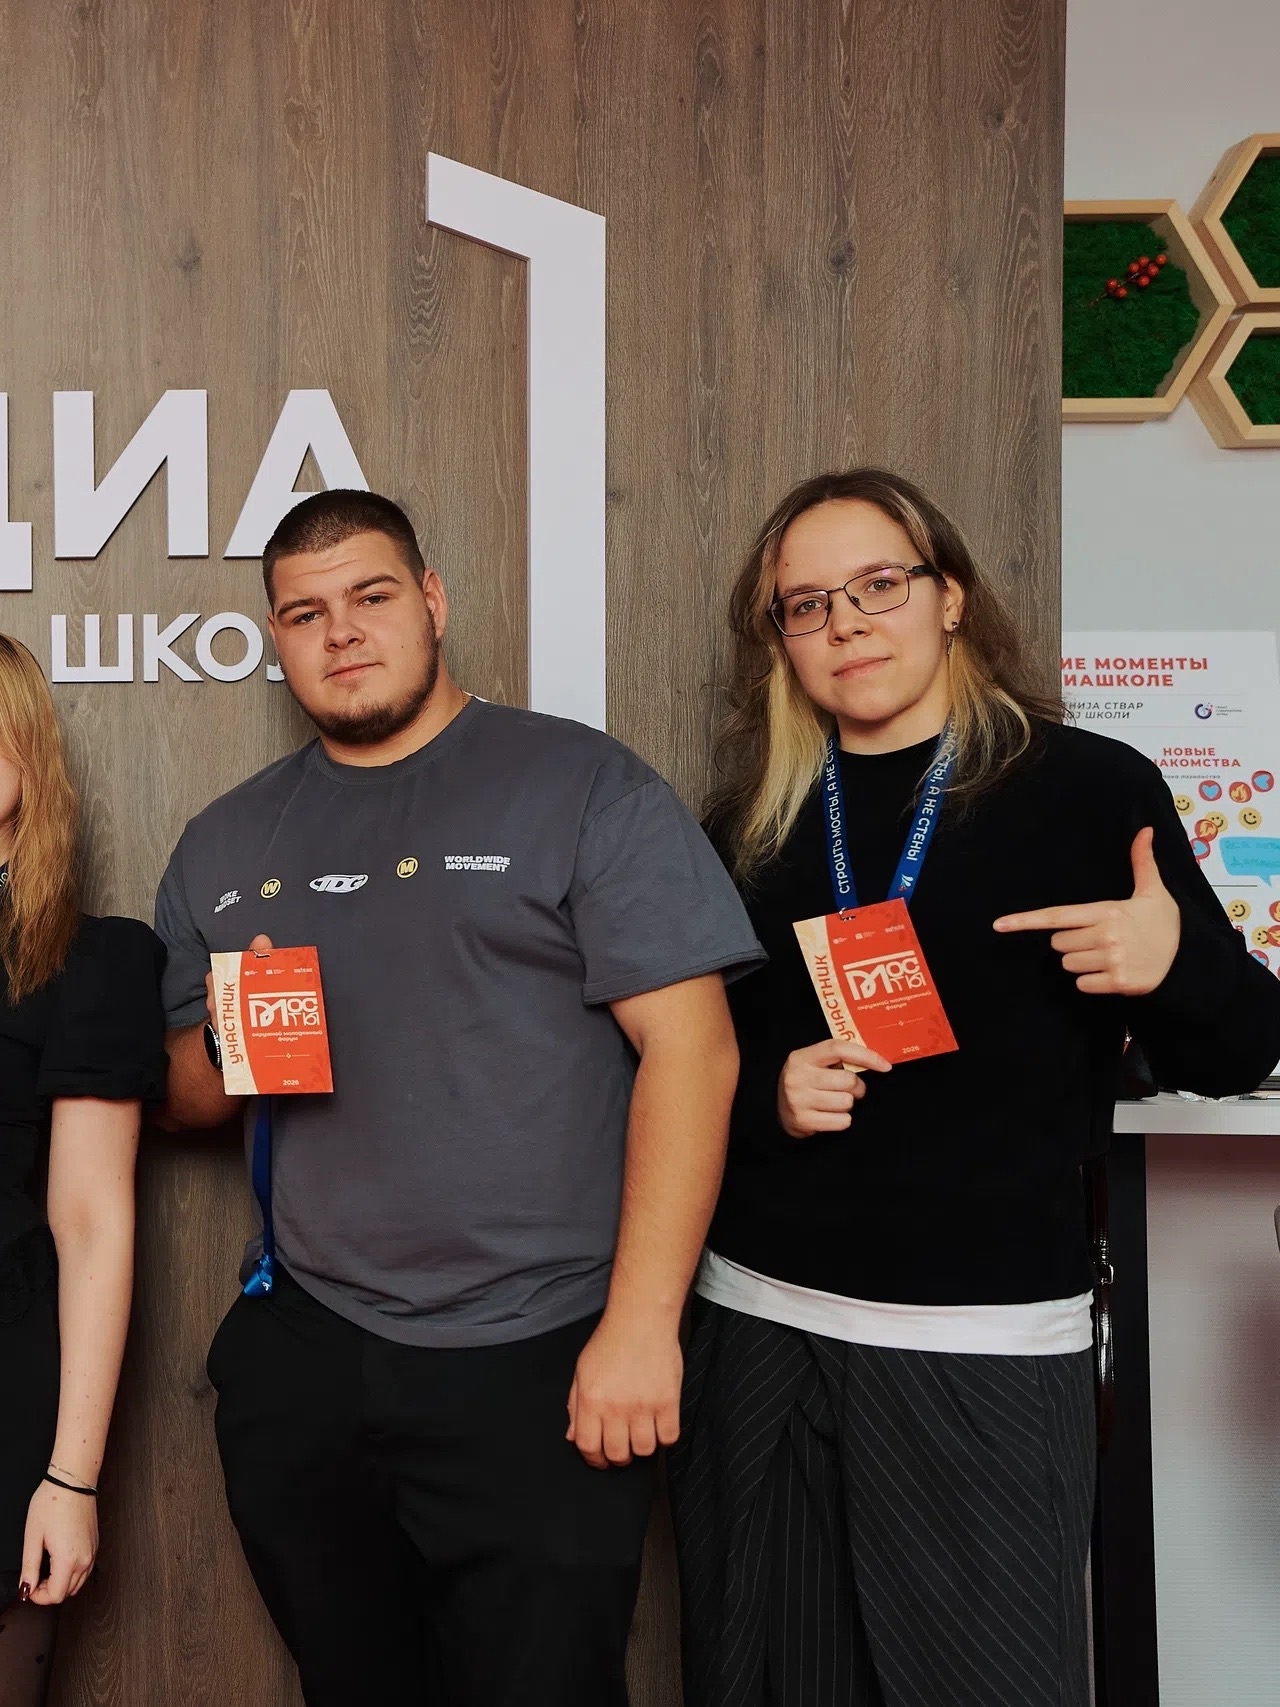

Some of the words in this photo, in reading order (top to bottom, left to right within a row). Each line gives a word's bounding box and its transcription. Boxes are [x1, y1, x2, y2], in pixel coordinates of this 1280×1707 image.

[51, 612, 288, 684] ШКО
[1095, 657, 1208, 670] МОМЕНТЫ
[1064, 674, 1174, 687] ИАШКОЛЕ
[1065, 702, 1099, 710] НИЈА
[1104, 702, 1144, 710] СТВАР
[1085, 711, 1130, 719] ШКОЛИ
[1163, 747, 1216, 756] НОВЫЕ
[826, 763, 836, 781] НЕ
[827, 781, 838, 791] А
[928, 786, 940, 796] А
[922, 798, 937, 816] НЕ
[829, 792, 842, 839] МОСТЫ,
[906, 817, 931, 862] СТЕНЫ
[444, 855, 510, 865] WORLDWIDE
[833, 839, 850, 894] СТРОИТЬ
[446, 862, 508, 872] MOVEMENT
[815, 954, 855, 1041] УЧАСТНИК
[222, 982, 243, 1065] УЧАСТНИК
